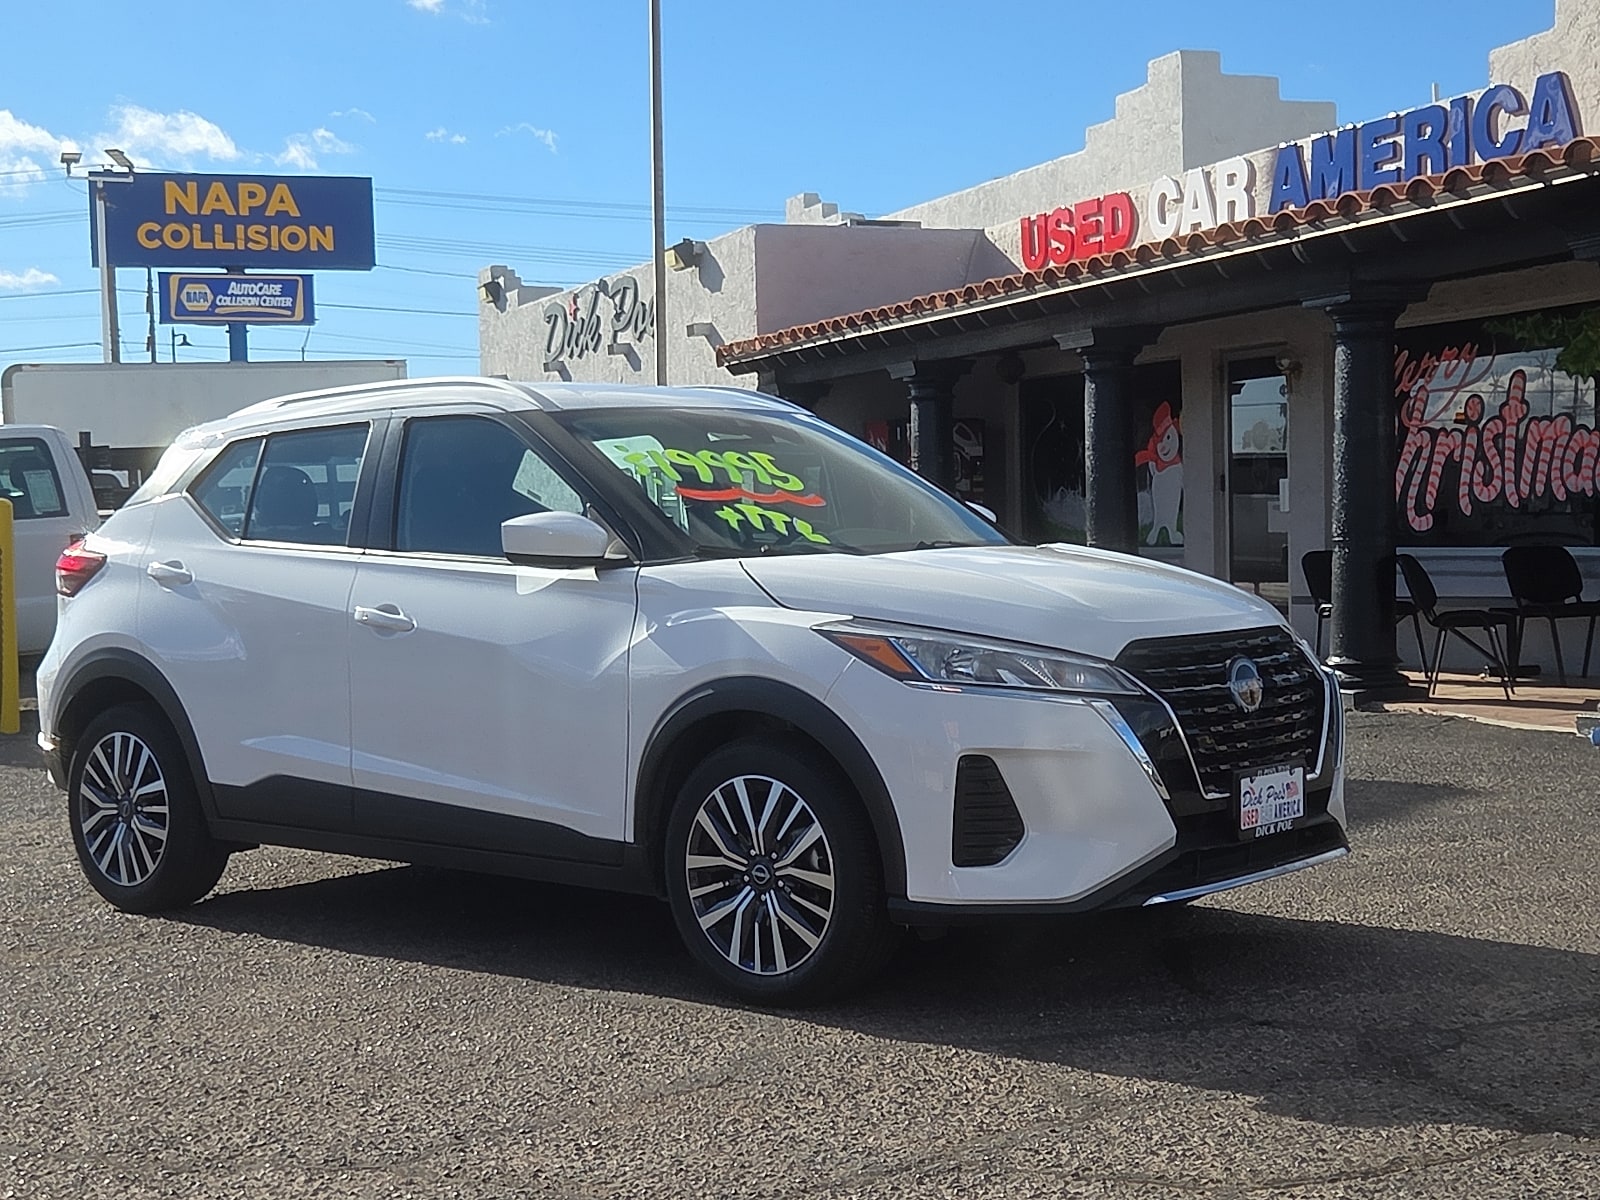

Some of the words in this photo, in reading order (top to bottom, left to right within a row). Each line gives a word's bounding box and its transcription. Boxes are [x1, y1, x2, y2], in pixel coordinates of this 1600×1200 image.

[1020, 192, 1137, 270] USED
[1148, 157, 1255, 240] CAR
[1268, 71, 1580, 214] AMERICA
[163, 180, 301, 217] NAPA
[137, 221, 334, 252] COLLISION
[186, 291, 209, 304] NAPA
[543, 283, 603, 362] Dick
[1255, 823, 1276, 838] DICK
[1277, 819, 1294, 832] POE
